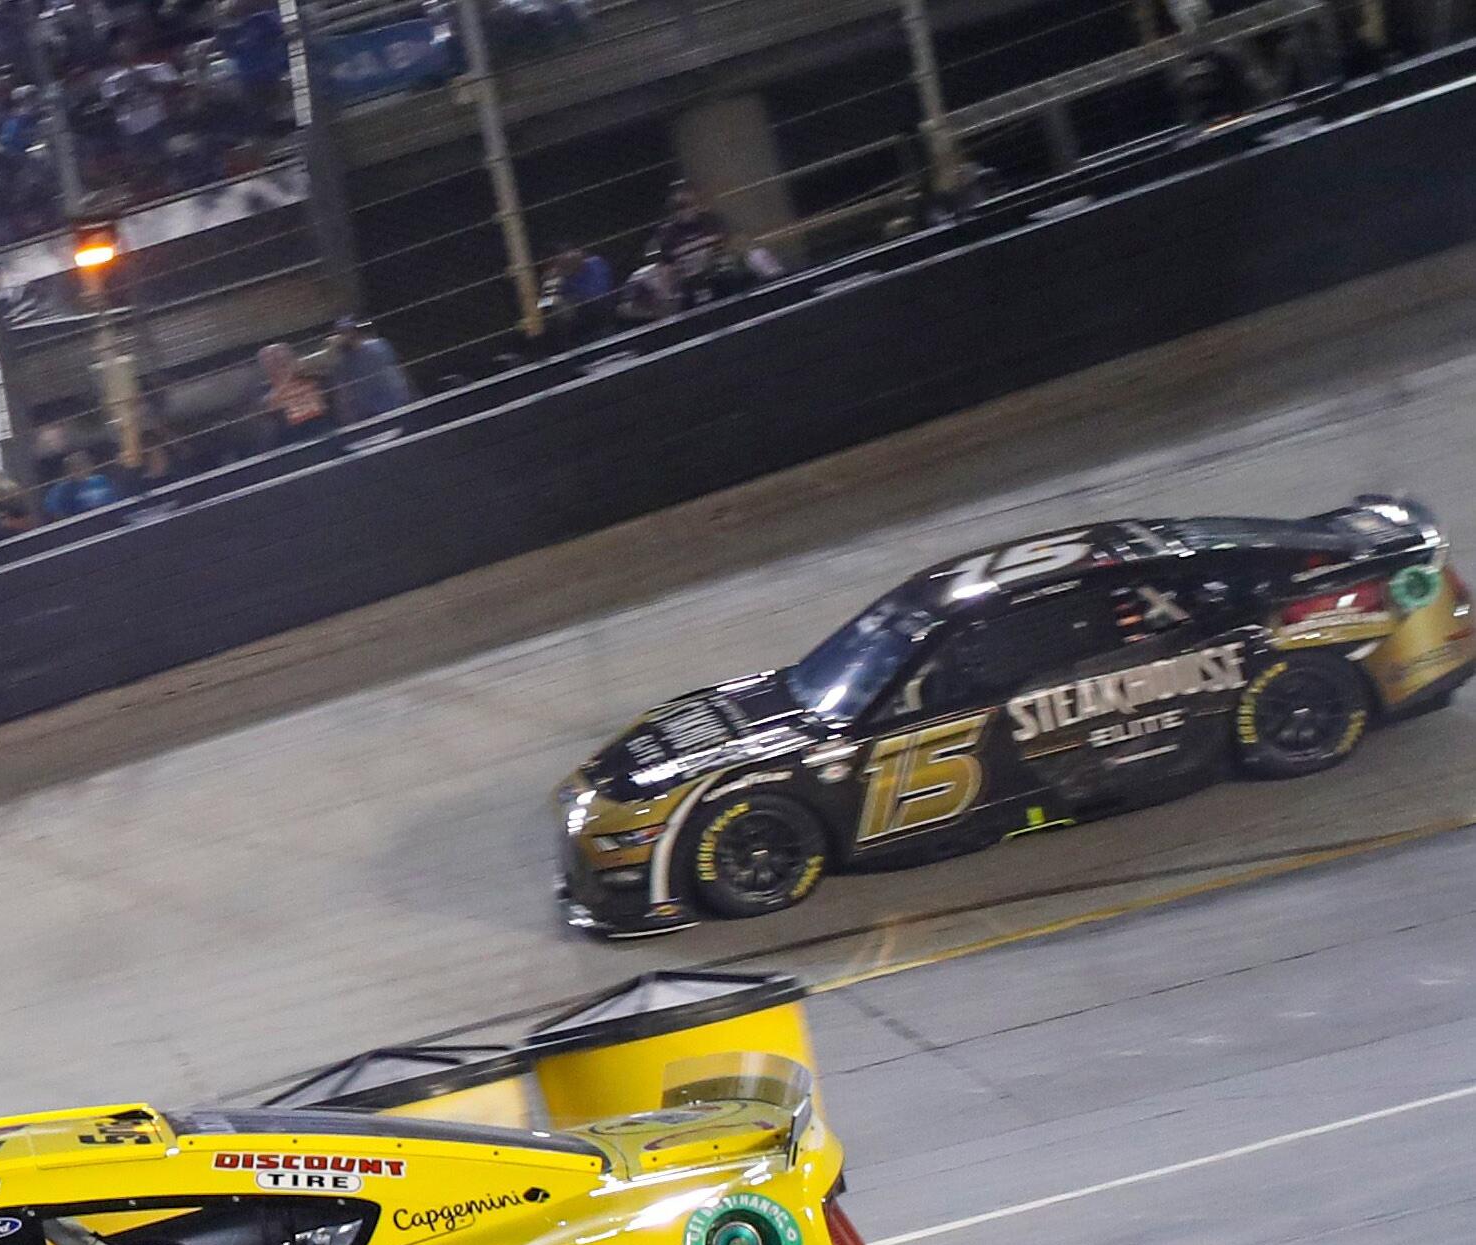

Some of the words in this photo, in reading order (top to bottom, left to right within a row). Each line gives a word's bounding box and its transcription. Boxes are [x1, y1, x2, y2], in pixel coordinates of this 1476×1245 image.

[856, 714, 989, 843] 15
[214, 1153, 405, 1176] DISCOUNT
[267, 1173, 350, 1190] TIRE
[393, 1191, 525, 1232] Capgemini
